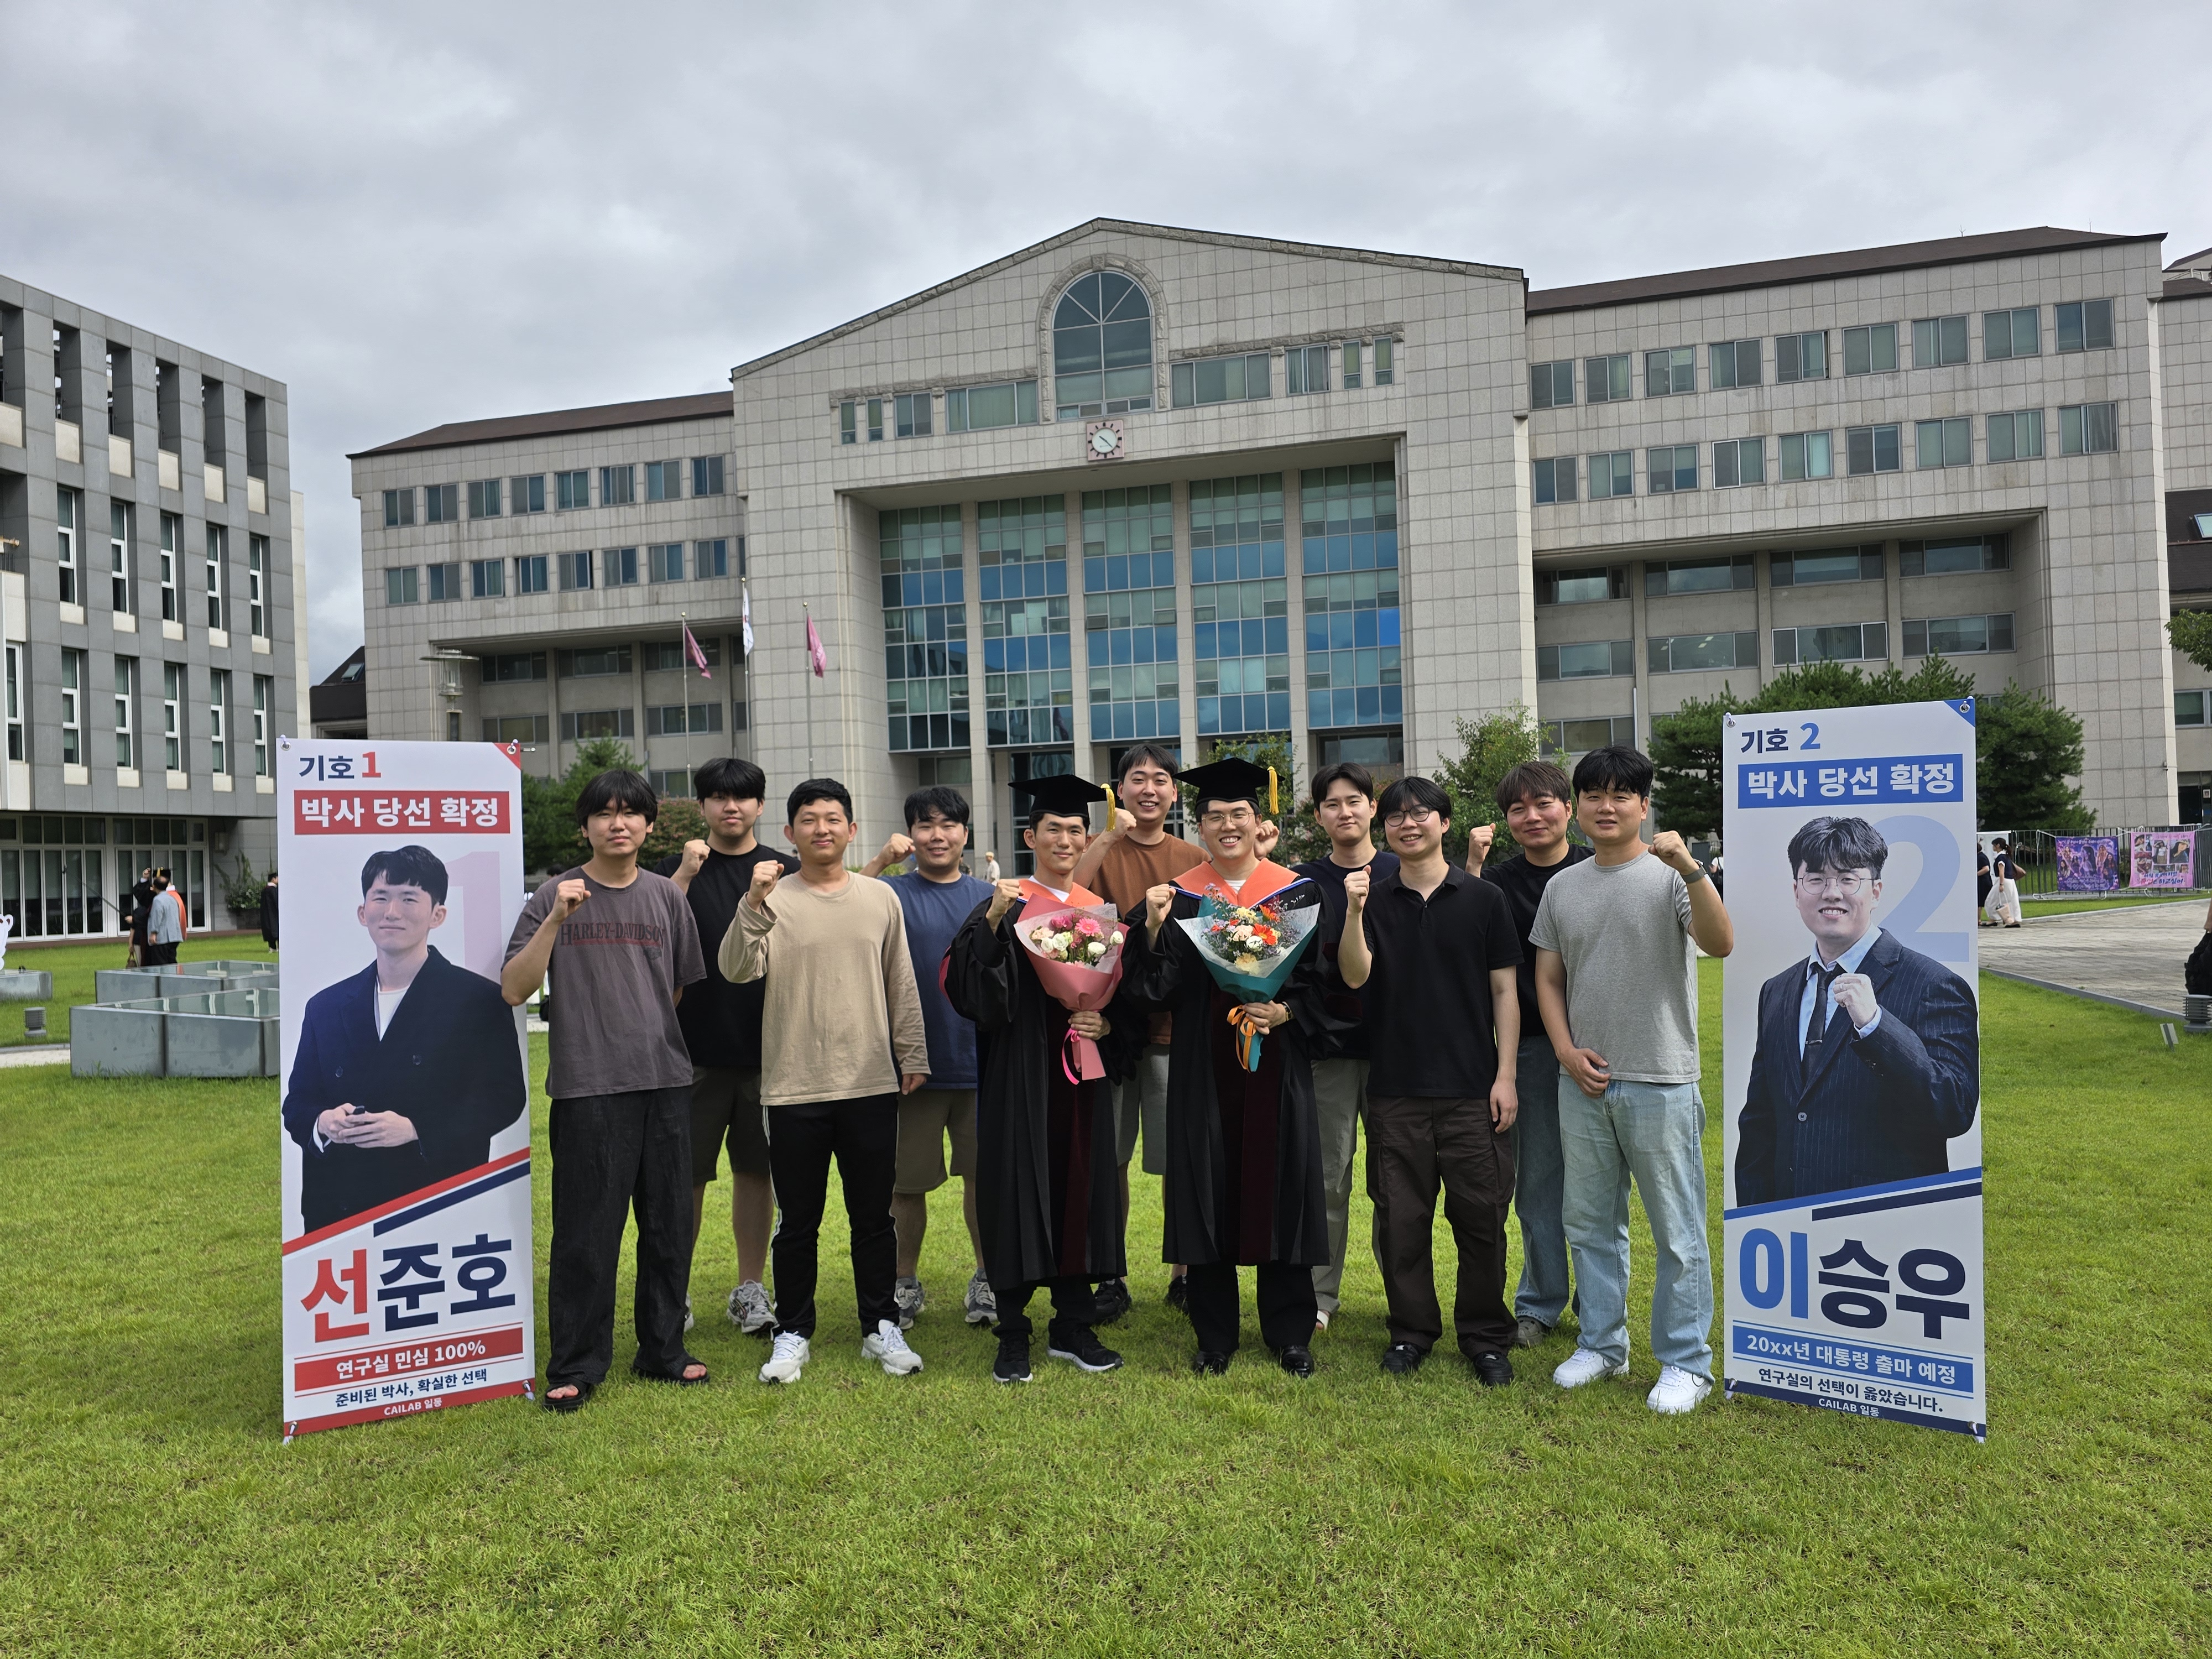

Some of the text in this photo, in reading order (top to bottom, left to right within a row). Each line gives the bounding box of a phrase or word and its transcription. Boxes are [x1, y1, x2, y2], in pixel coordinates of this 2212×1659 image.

[1741, 722, 1820, 754] 기호 2
[299, 752, 381, 781] 기호 1
[1748, 763, 1954, 799] 박사 당선 확정
[301, 797, 498, 827] 박사 당선 확정
[1874, 815, 1969, 962] 2
[445, 851, 502, 985] 1
[561, 923, 665, 948] HARLEY-DAVIDSON
[300, 1233, 515, 1343] 선준호
[1739, 1228, 1969, 1340] 이승우
[336, 1340, 486, 1380] 연구실 민심 100%
[1747, 1334, 1956, 1384] 20xx년 대통령 출마 예정
[335, 1369, 488, 1407] 준비된 박사, 확실한 선택
[384, 1397, 442, 1416] CAILAB 일동
[1759, 1368, 1943, 1412] 연구실의 선택이 옳았습니다.
[1819, 1397, 1880, 1417] CAILAB 일동
